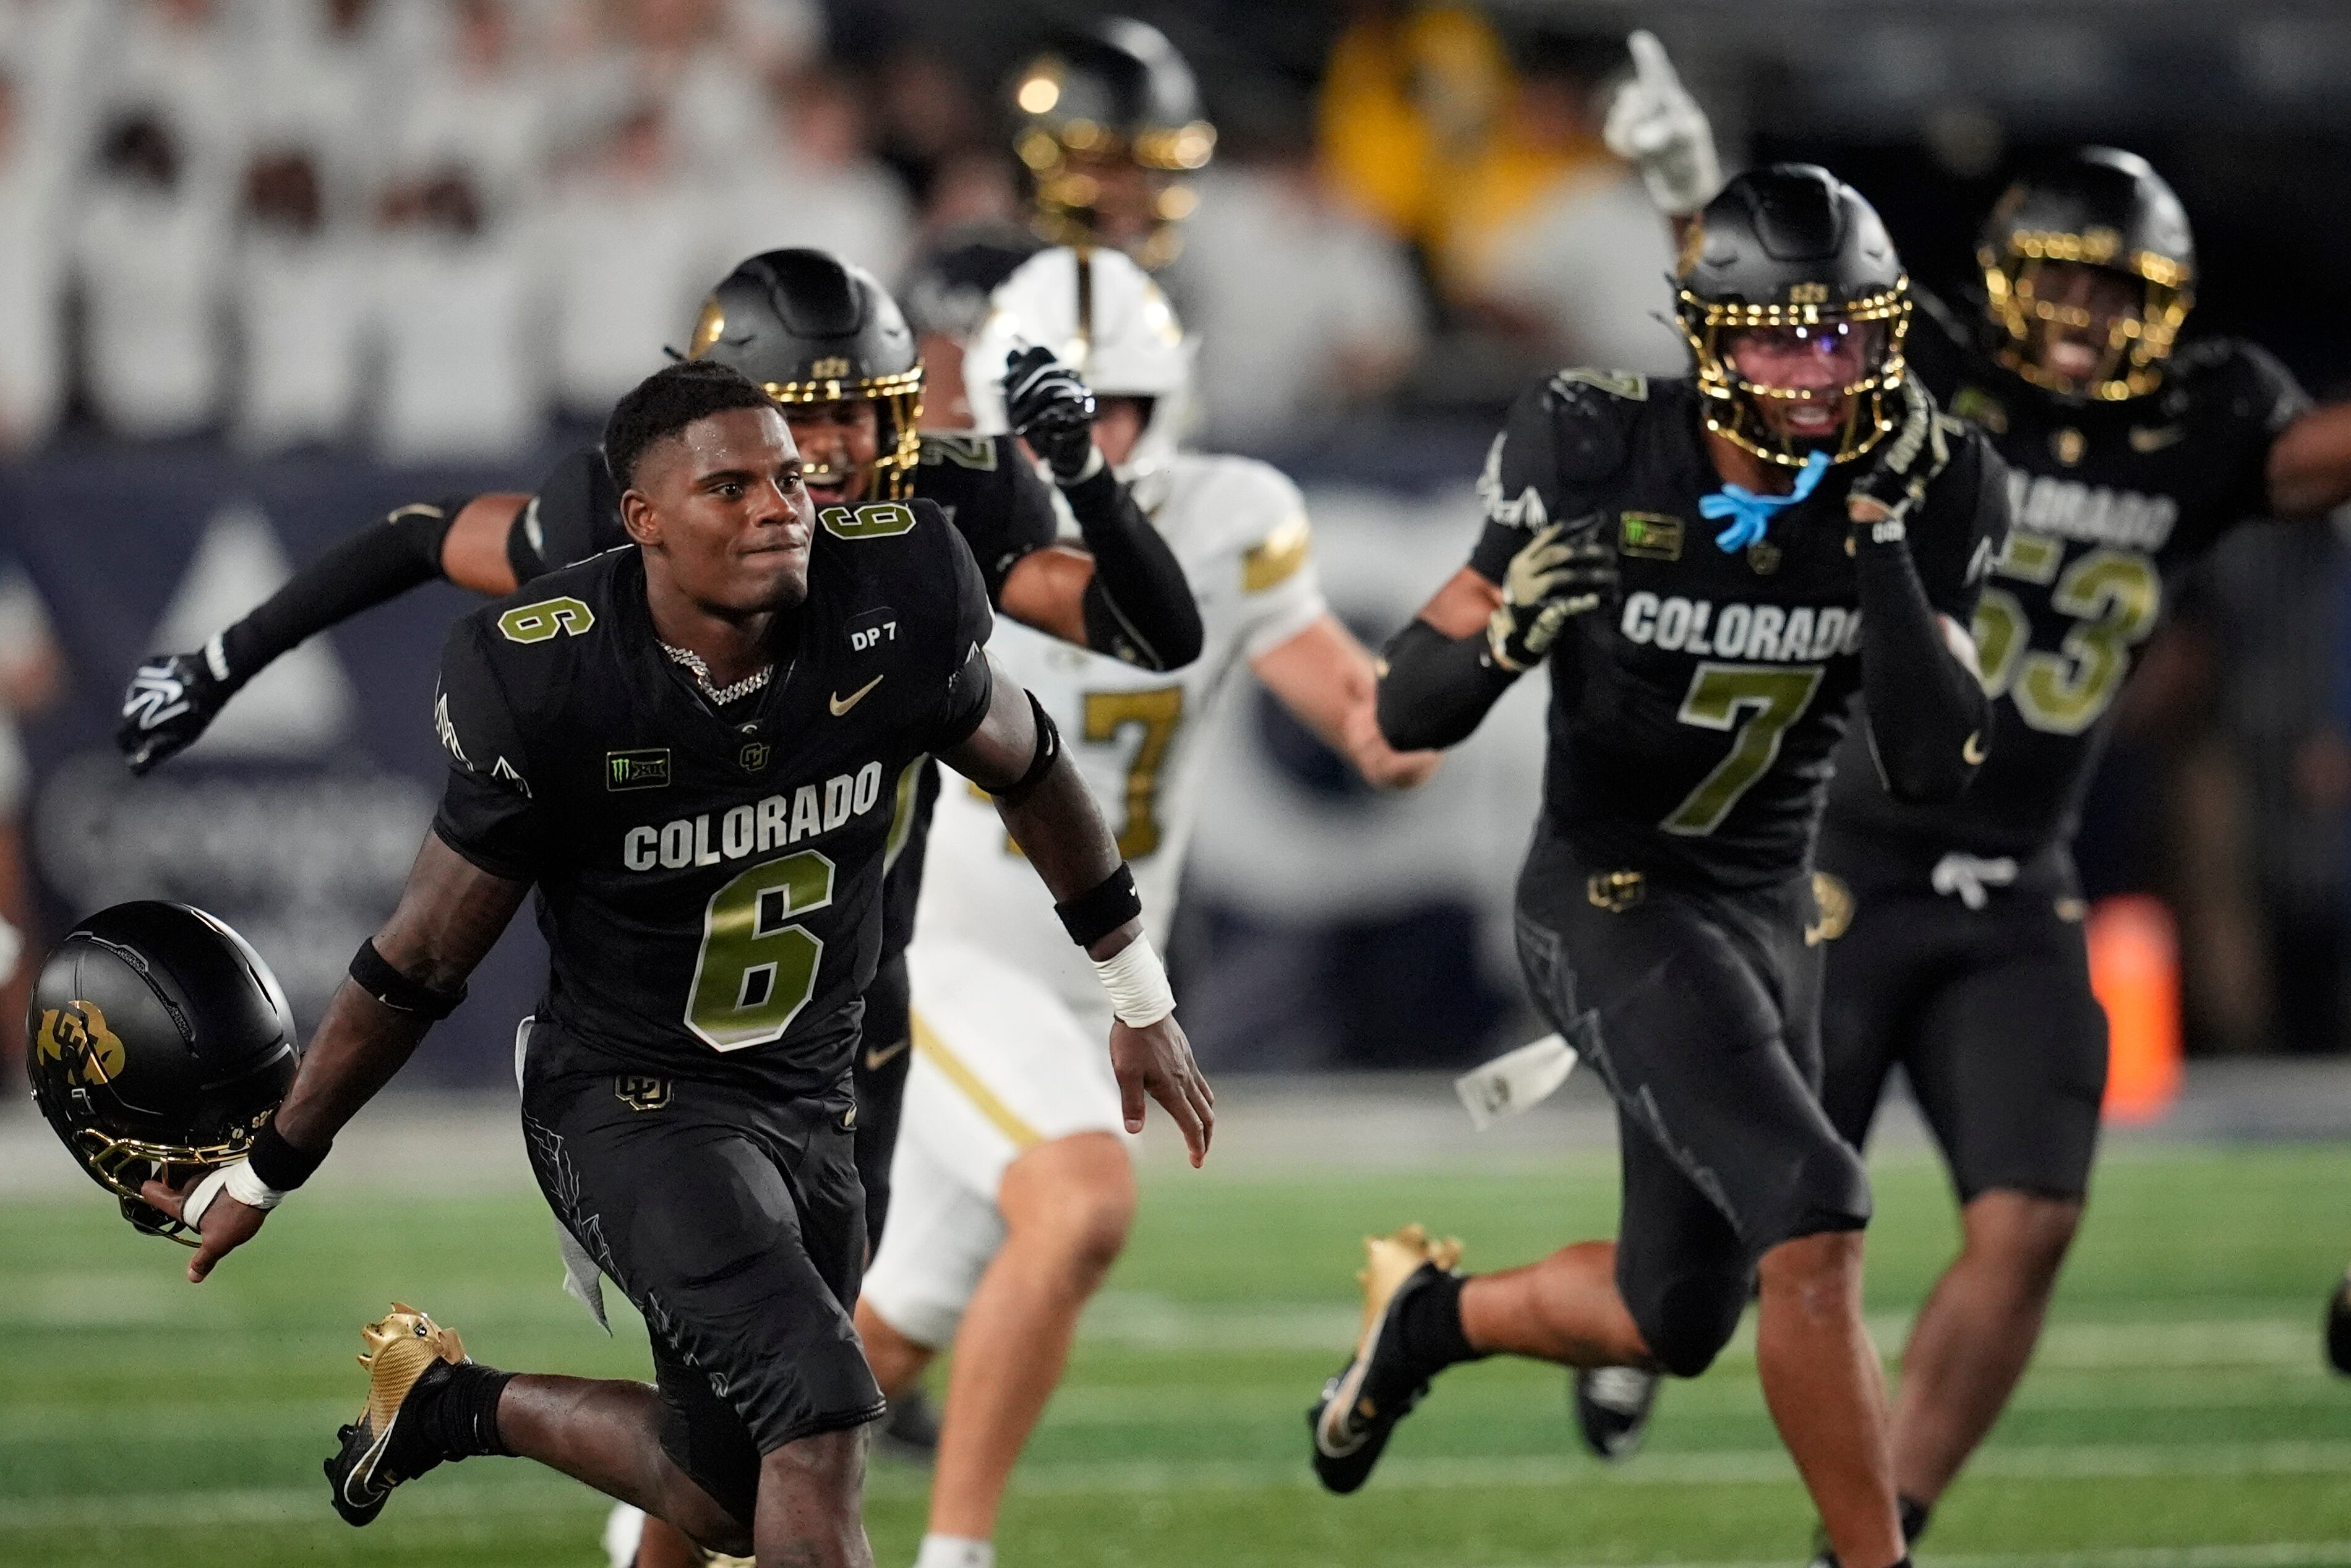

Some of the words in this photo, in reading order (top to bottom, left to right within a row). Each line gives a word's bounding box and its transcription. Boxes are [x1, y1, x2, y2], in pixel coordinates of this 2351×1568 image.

[818, 502, 917, 541] 6
[497, 595, 596, 645] 6
[851, 627, 880, 651] DP
[883, 621, 896, 641] 7
[1971, 529, 2162, 736] 53
[1658, 662, 1825, 838] 7
[624, 761, 882, 871] COLORADO
[683, 849, 836, 1053] 6
